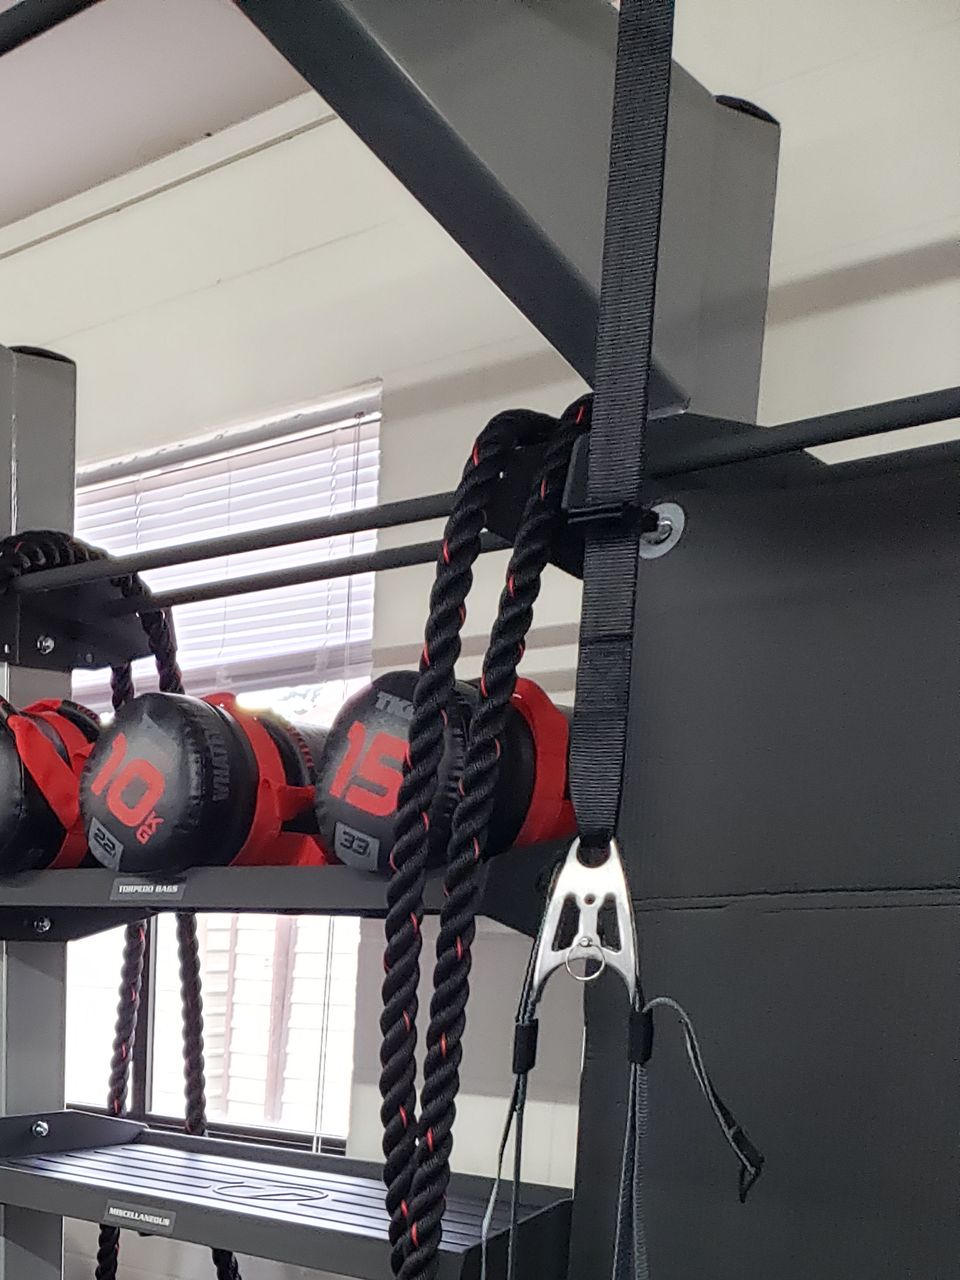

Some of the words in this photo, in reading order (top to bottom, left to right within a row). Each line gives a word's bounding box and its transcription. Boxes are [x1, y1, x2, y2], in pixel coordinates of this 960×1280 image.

[91, 732, 165, 827] 10
[329, 720, 410, 816] 15
[93, 827, 117, 857] 22
[135, 811, 165, 844] KG
[339, 829, 371, 858] 33
[118, 885, 154, 893] TORPEDO
[155, 885, 178, 893] BAGS
[109, 1207, 170, 1226] MISCELLANEOUS
